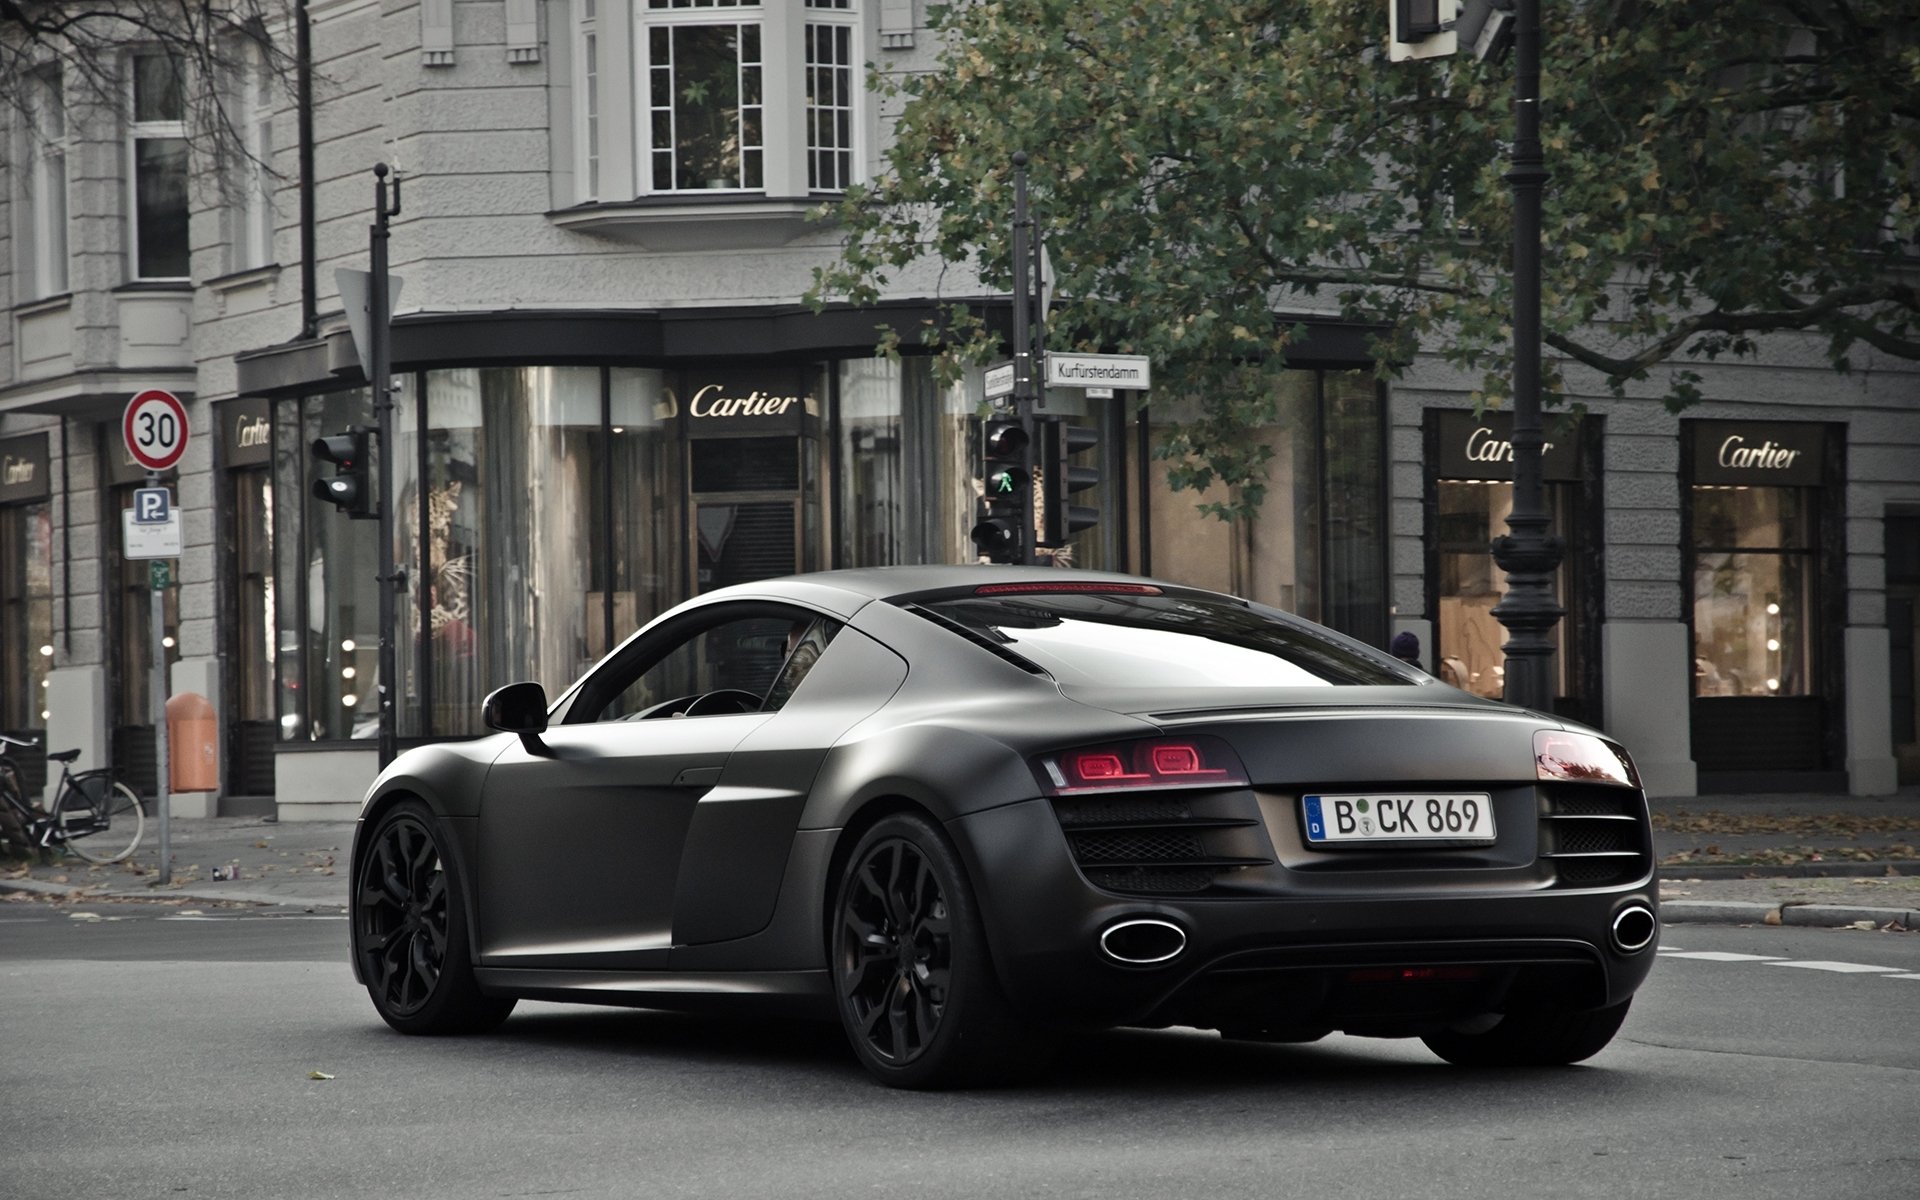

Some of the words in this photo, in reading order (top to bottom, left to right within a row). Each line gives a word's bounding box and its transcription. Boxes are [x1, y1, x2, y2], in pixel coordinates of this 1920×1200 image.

[1058, 362, 1139, 380] Kurfürstendamm
[689, 384, 798, 418] Cartier
[138, 412, 175, 448] 30
[236, 414, 270, 448] Cartie
[1465, 427, 1554, 462] Carr
[1719, 435, 1801, 468] Cartier
[142, 493, 162, 519] P
[1312, 822, 1320, 833] D
[1334, 801, 1356, 834] B
[1376, 799, 1419, 833] CK
[1425, 799, 1479, 833] 869
